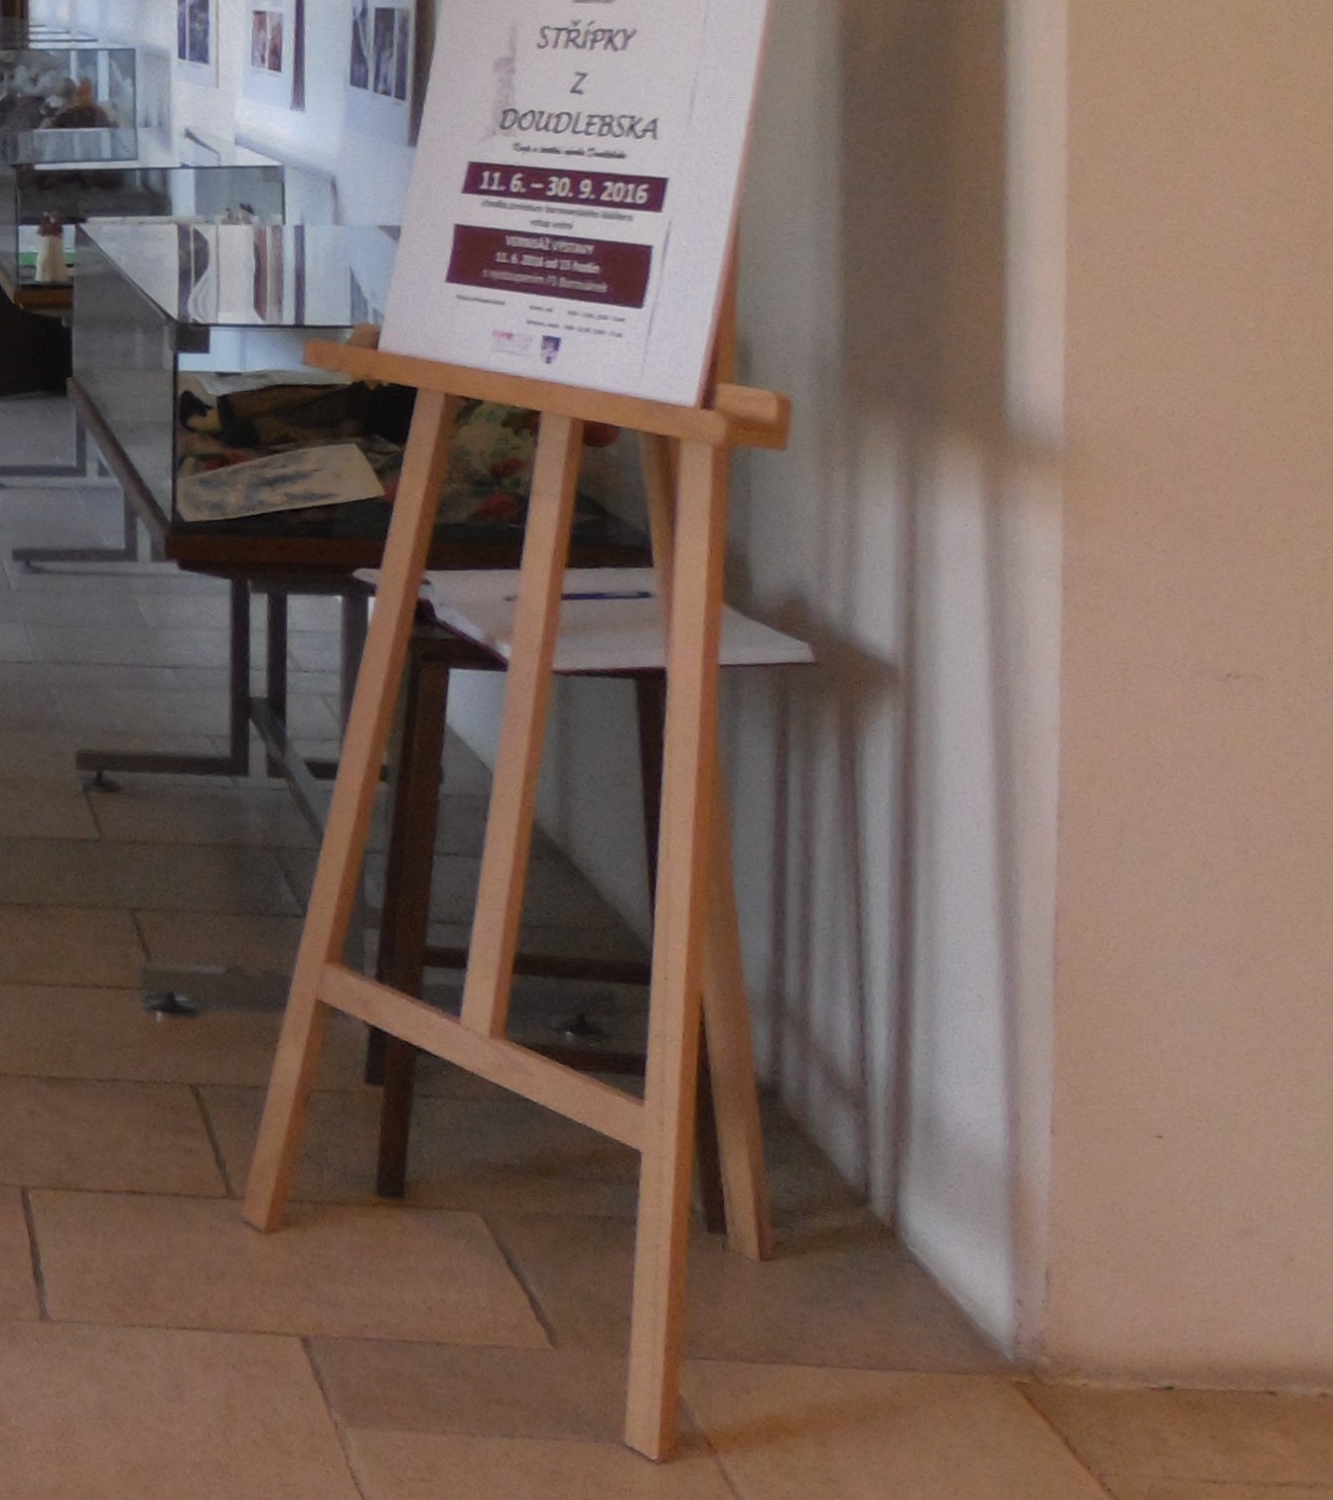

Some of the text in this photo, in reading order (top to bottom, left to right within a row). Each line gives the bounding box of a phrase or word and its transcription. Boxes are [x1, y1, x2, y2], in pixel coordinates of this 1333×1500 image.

[536, 19, 638, 52] STŘÍPKY
[499, 108, 659, 141] DOUDLEBSKA
[479, 170, 506, 192] 11.
[509, 172, 527, 193] 6.
[545, 176, 574, 199] 30.
[578, 179, 596, 200] 9.
[599, 181, 650, 205] 2016
